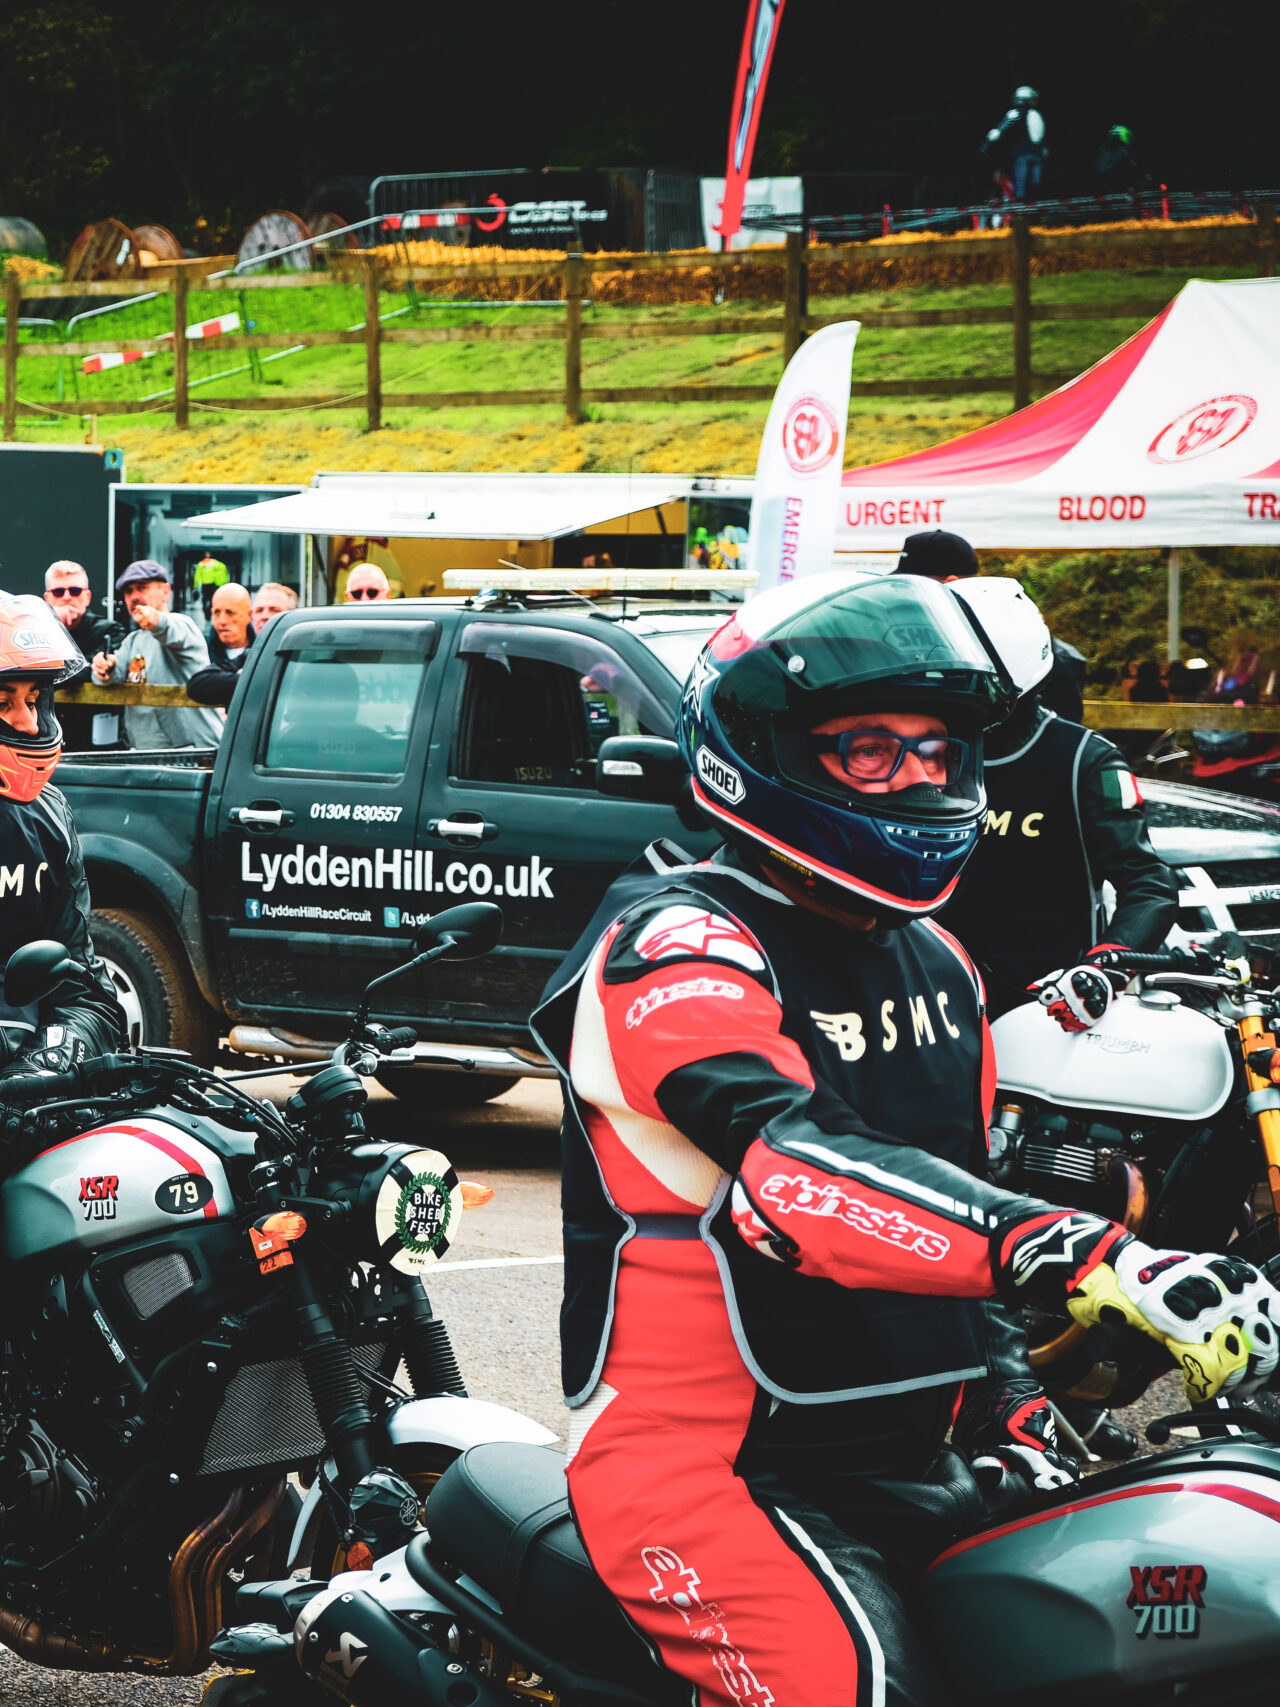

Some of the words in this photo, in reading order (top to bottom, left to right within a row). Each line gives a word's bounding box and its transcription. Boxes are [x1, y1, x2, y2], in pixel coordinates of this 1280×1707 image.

[846, 499, 945, 526] URGENT
[1058, 495, 1147, 521] BLOOD
[1243, 492, 1280, 519] TR
[701, 754, 737, 796] SHOEI
[310, 803, 350, 820] 01304
[352, 805, 402, 822] 830557
[241, 841, 554, 898] LyddenHill.co.uk
[810, 991, 960, 1062] BSMC
[79, 1175, 119, 1201] XSR
[169, 1181, 199, 1207] 79
[414, 1192, 441, 1206] BIKE
[82, 1199, 117, 1221] 700
[409, 1207, 442, 1220] SHED
[760, 1174, 950, 1261] alpinestars
[409, 1220, 438, 1234] FEST
[1126, 1565, 1207, 1608] XSR
[1133, 1605, 1200, 1640] 700
